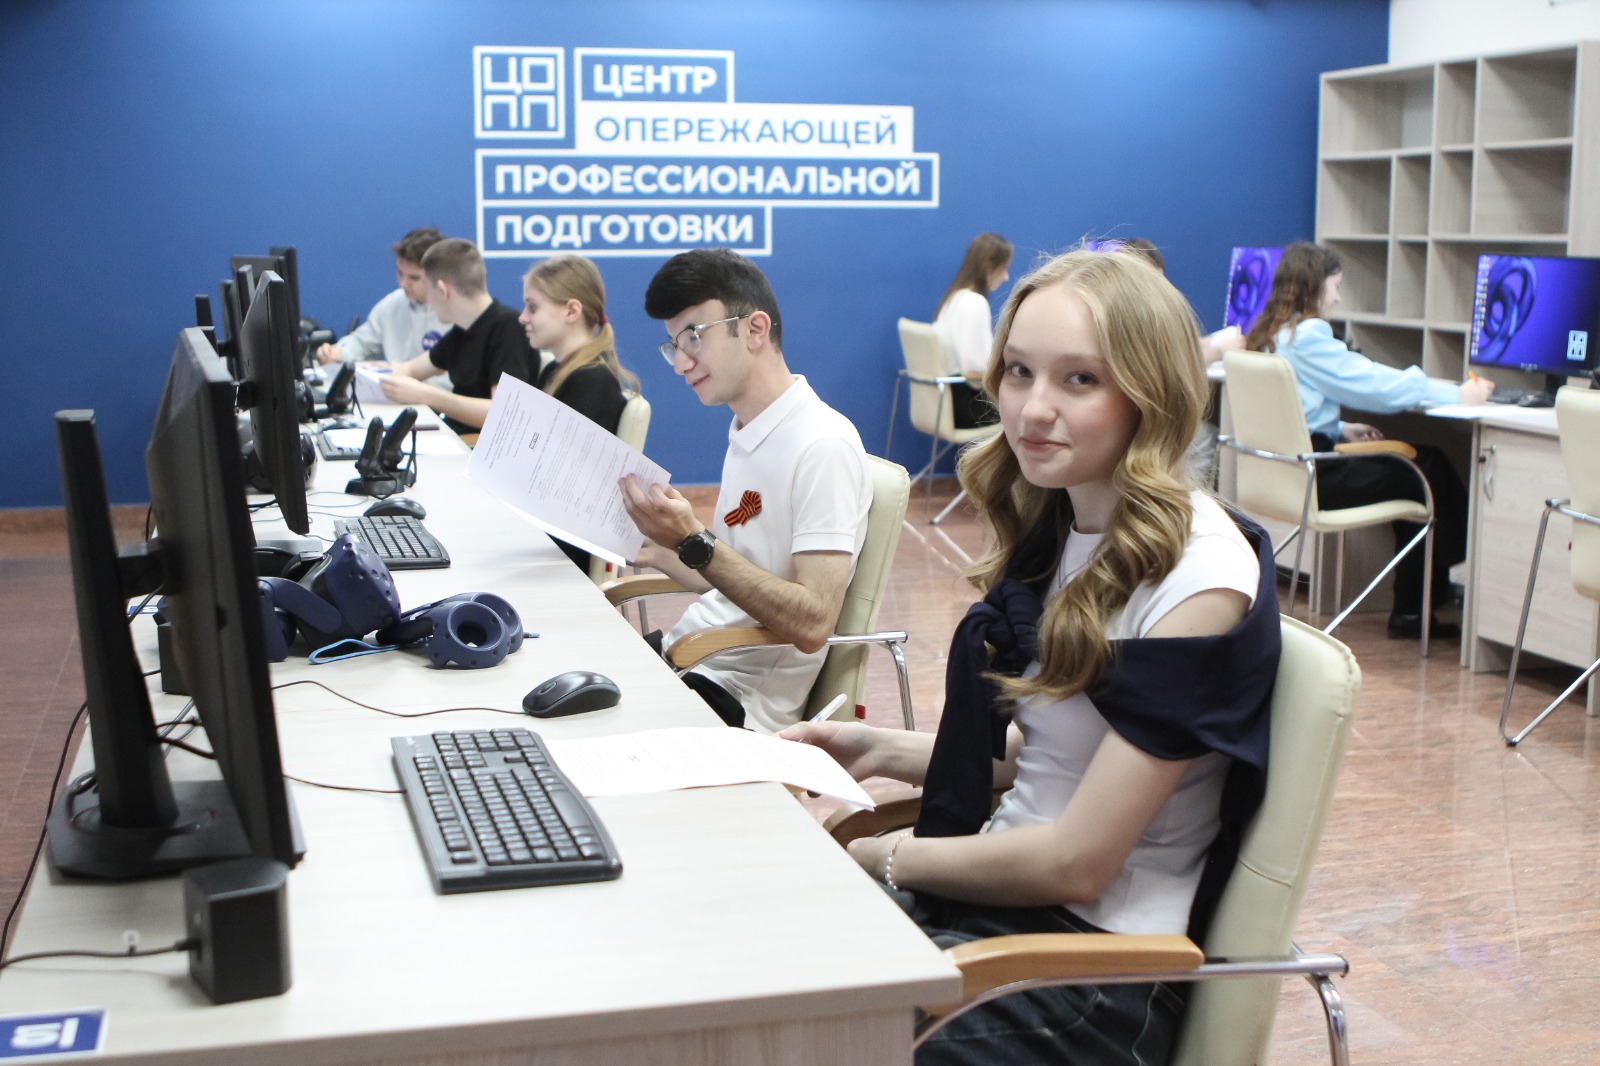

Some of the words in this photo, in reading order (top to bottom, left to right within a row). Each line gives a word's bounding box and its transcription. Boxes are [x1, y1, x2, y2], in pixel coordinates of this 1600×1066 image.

[593, 63, 718, 97] ЦЕНТР
[594, 114, 897, 150] ОПЕРЕЖАЮЩЕЙ
[495, 161, 921, 195] ПРОФЕССИОНАЛЬНОЙ
[496, 214, 754, 248] ПОДГОТОВКИ
